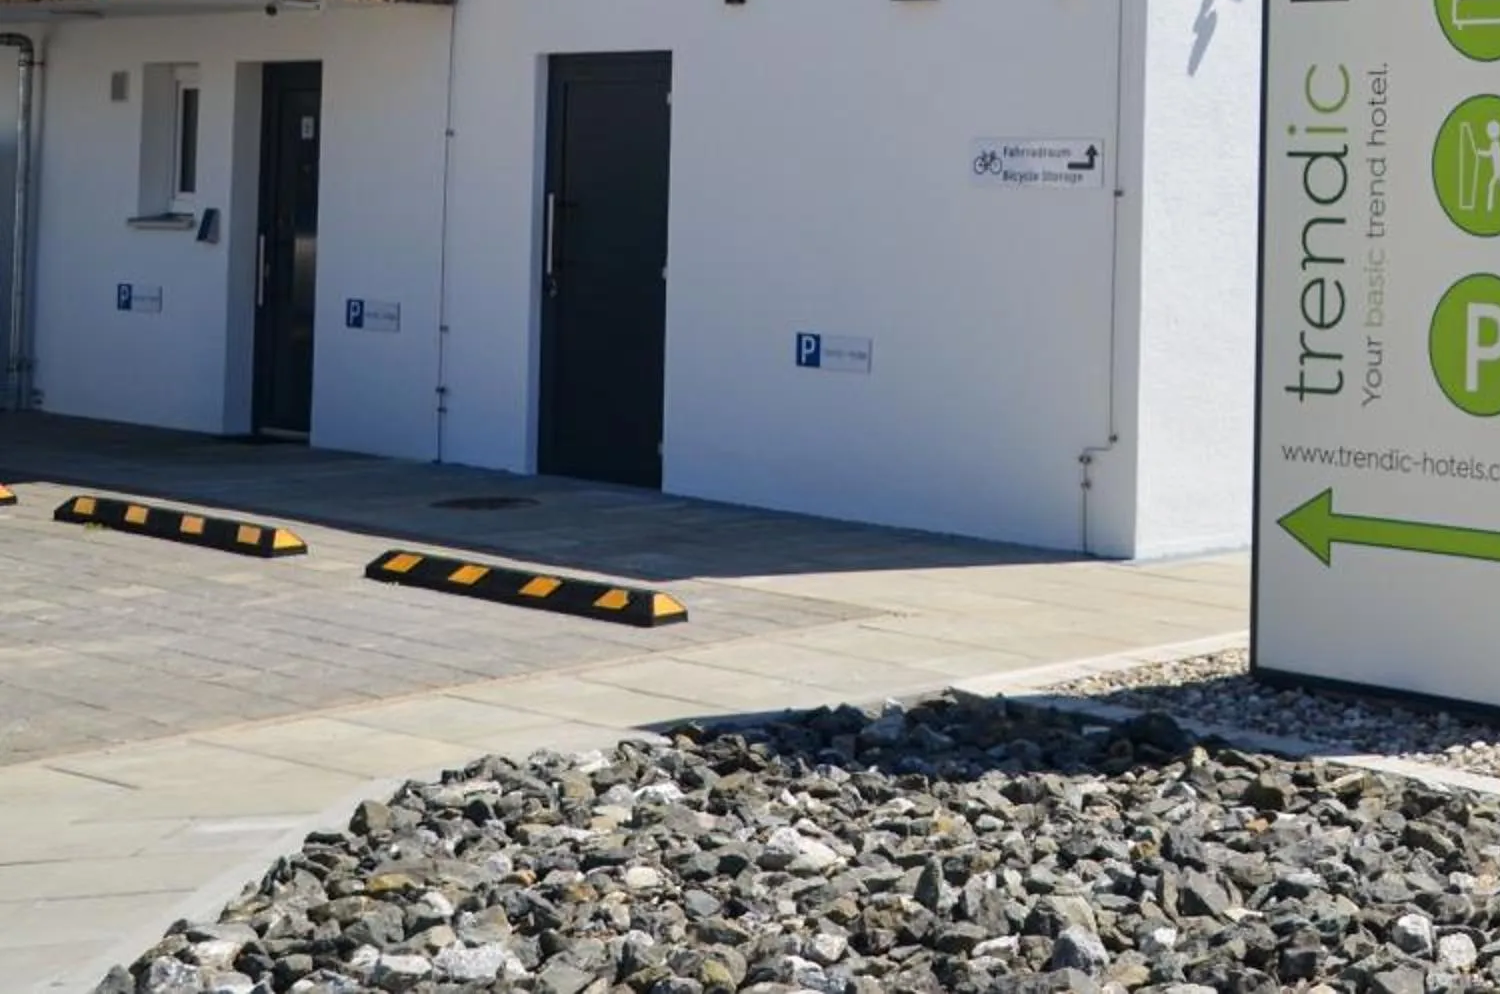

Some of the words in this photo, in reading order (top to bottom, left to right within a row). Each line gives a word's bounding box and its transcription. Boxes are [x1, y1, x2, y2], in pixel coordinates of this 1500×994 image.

[1366, 63, 1389, 148] hotel.
[1284, 63, 1350, 402] trendic
[1366, 157, 1386, 239] trend
[350, 301, 361, 324] P
[1364, 248, 1386, 329] basic
[801, 335, 816, 365] P
[1361, 336, 1383, 408] Your
